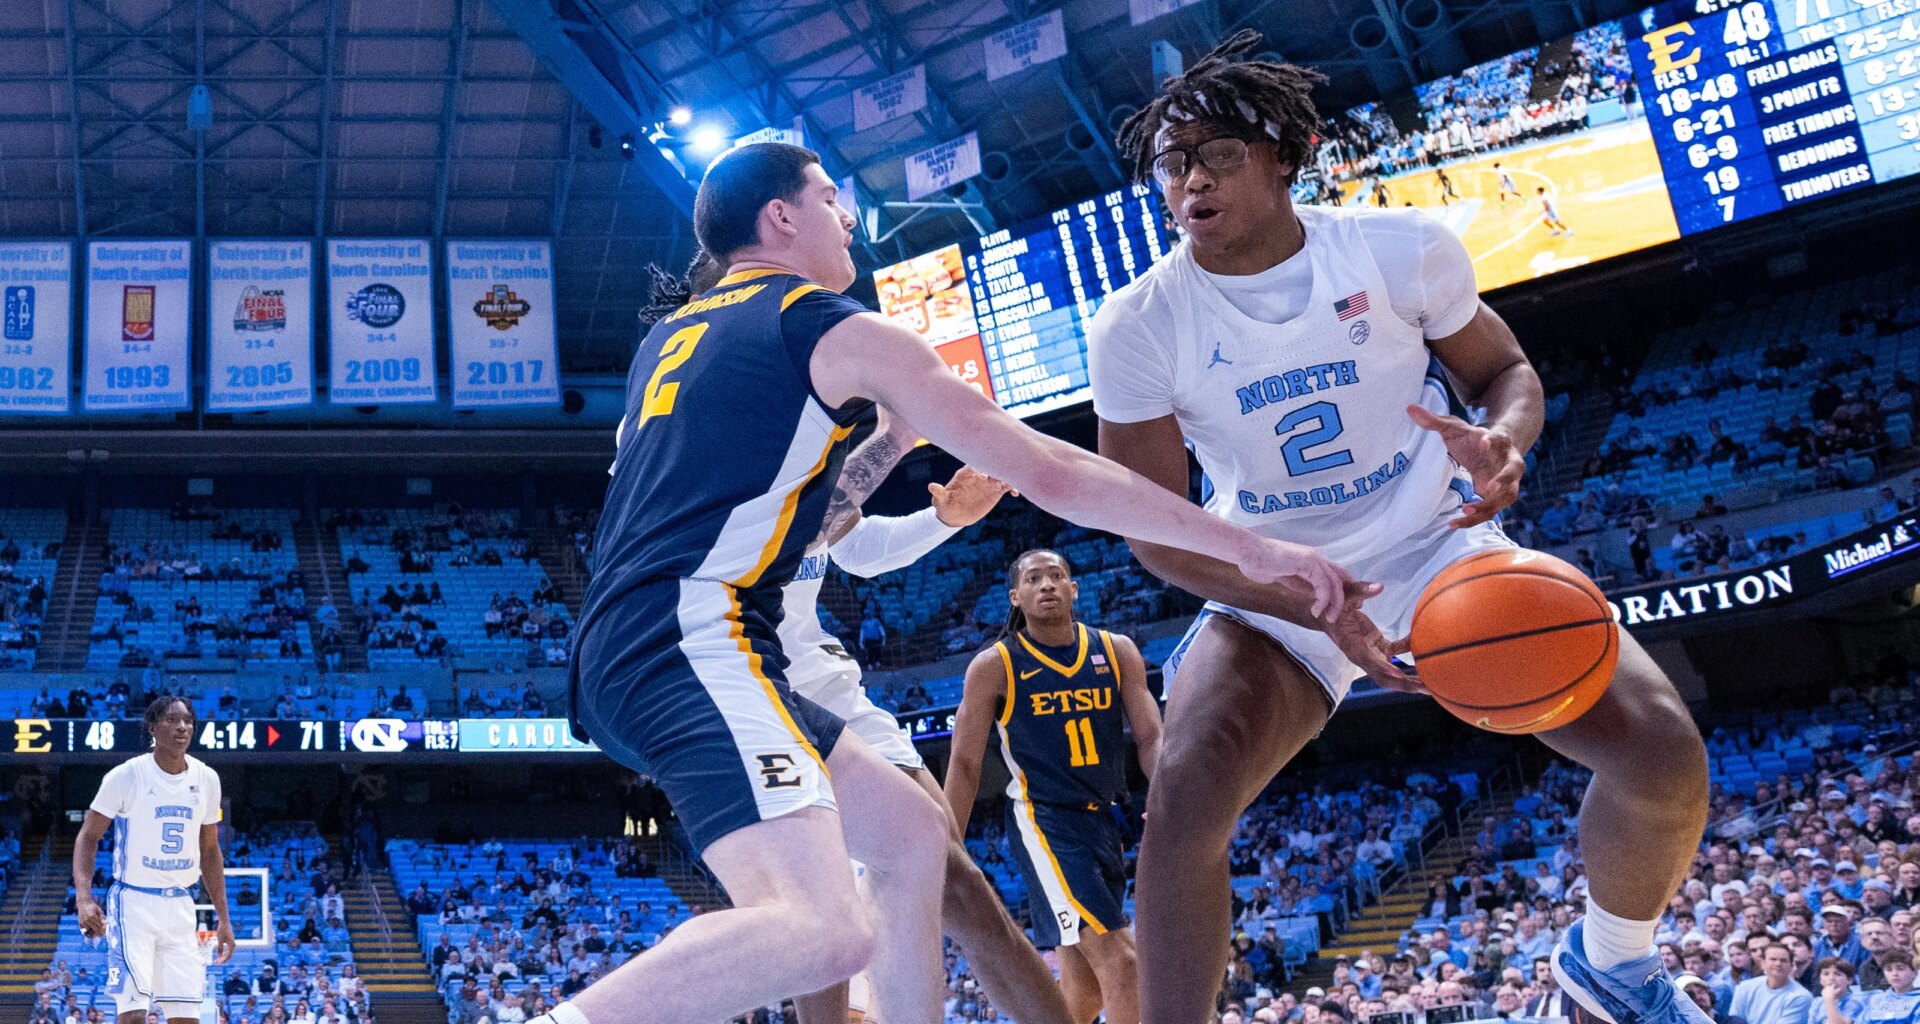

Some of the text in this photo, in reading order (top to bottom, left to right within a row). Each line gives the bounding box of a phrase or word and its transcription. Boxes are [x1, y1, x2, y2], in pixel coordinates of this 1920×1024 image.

[1723, 1, 1770, 46] 48
[1642, 21, 1701, 75] E
[1656, 17, 1920, 117] 18-48 FIELD GOALS 25-4
[1672, 46, 1920, 143] 6-21 3 POINT FG 8-2
[1687, 81, 1920, 168] 6-9 FREE THROWS 13-
[930, 160, 954, 179] 2017
[1704, 166, 1740, 195] 19
[1777, 136, 1858, 172] REBOUNDS
[1717, 164, 1871, 222] 7 TURNOVERS
[980, 229, 1011, 249] PLAYER
[1052, 208, 1070, 224] PTS
[1105, 191, 1122, 207] AST
[982, 237, 1028, 266] JOHNSON
[1085, 215, 1097, 232] 3
[1111, 205, 1124, 223] 0
[1140, 197, 1149, 213] 1
[97, 247, 182, 261] University of
[217, 247, 304, 261] University of
[336, 244, 421, 258] University of
[457, 246, 542, 261] University of
[972, 270, 981, 284] 4
[984, 258, 1018, 281] SMITH
[1090, 231, 1099, 247] 1
[1116, 222, 1126, 238] 1
[12, 267, 68, 281] Carolina
[92, 266, 187, 281] North Carolina
[212, 266, 307, 280] North Carolina
[332, 263, 428, 277] North Carolina
[451, 266, 548, 279] North Carolina
[367, 293, 399, 304] FINAL
[974, 285, 985, 300] 11
[987, 272, 1026, 296] TAYLOR
[244, 297, 284, 309] FINAL
[249, 310, 285, 322] FOUR
[358, 301, 399, 316] FOUR
[994, 296, 1052, 326] MCCOLLUM
[245, 339, 275, 349] 33-4
[985, 330, 995, 345] 0
[998, 319, 1031, 341] EVANS
[1001, 333, 1039, 356] BROWN
[0, 366, 54, 390] 982
[105, 365, 170, 388] 1993
[226, 361, 293, 388] 2005
[345, 358, 420, 383] 2009
[468, 360, 543, 384] 2017
[638, 322, 710, 430] 2
[995, 376, 1007, 391] 11
[1009, 363, 1049, 387] POWELL
[332, 386, 432, 398] NATIONAL CHAMPIONS
[1012, 374, 1071, 402] STEVENSON
[1236, 360, 1359, 415] NORTH
[1275, 400, 1354, 477] 2
[1238, 451, 1410, 514] CAROLINA
[1824, 533, 1892, 574] Michael
[1893, 525, 1912, 546] &
[1030, 687, 1111, 716] ETSU
[14, 718, 52, 752] E
[85, 721, 115, 750] 48
[199, 721, 256, 749] 4:14
[300, 721, 324, 750] 71
[489, 724, 584, 747] CAROL
[425, 735, 449, 750] FLS:
[1065, 717, 1099, 767] 11
[756, 753, 801, 789] E
[155, 805, 193, 819] NORTH
[161, 823, 184, 853] 5
[142, 855, 194, 871] CAROLINA
